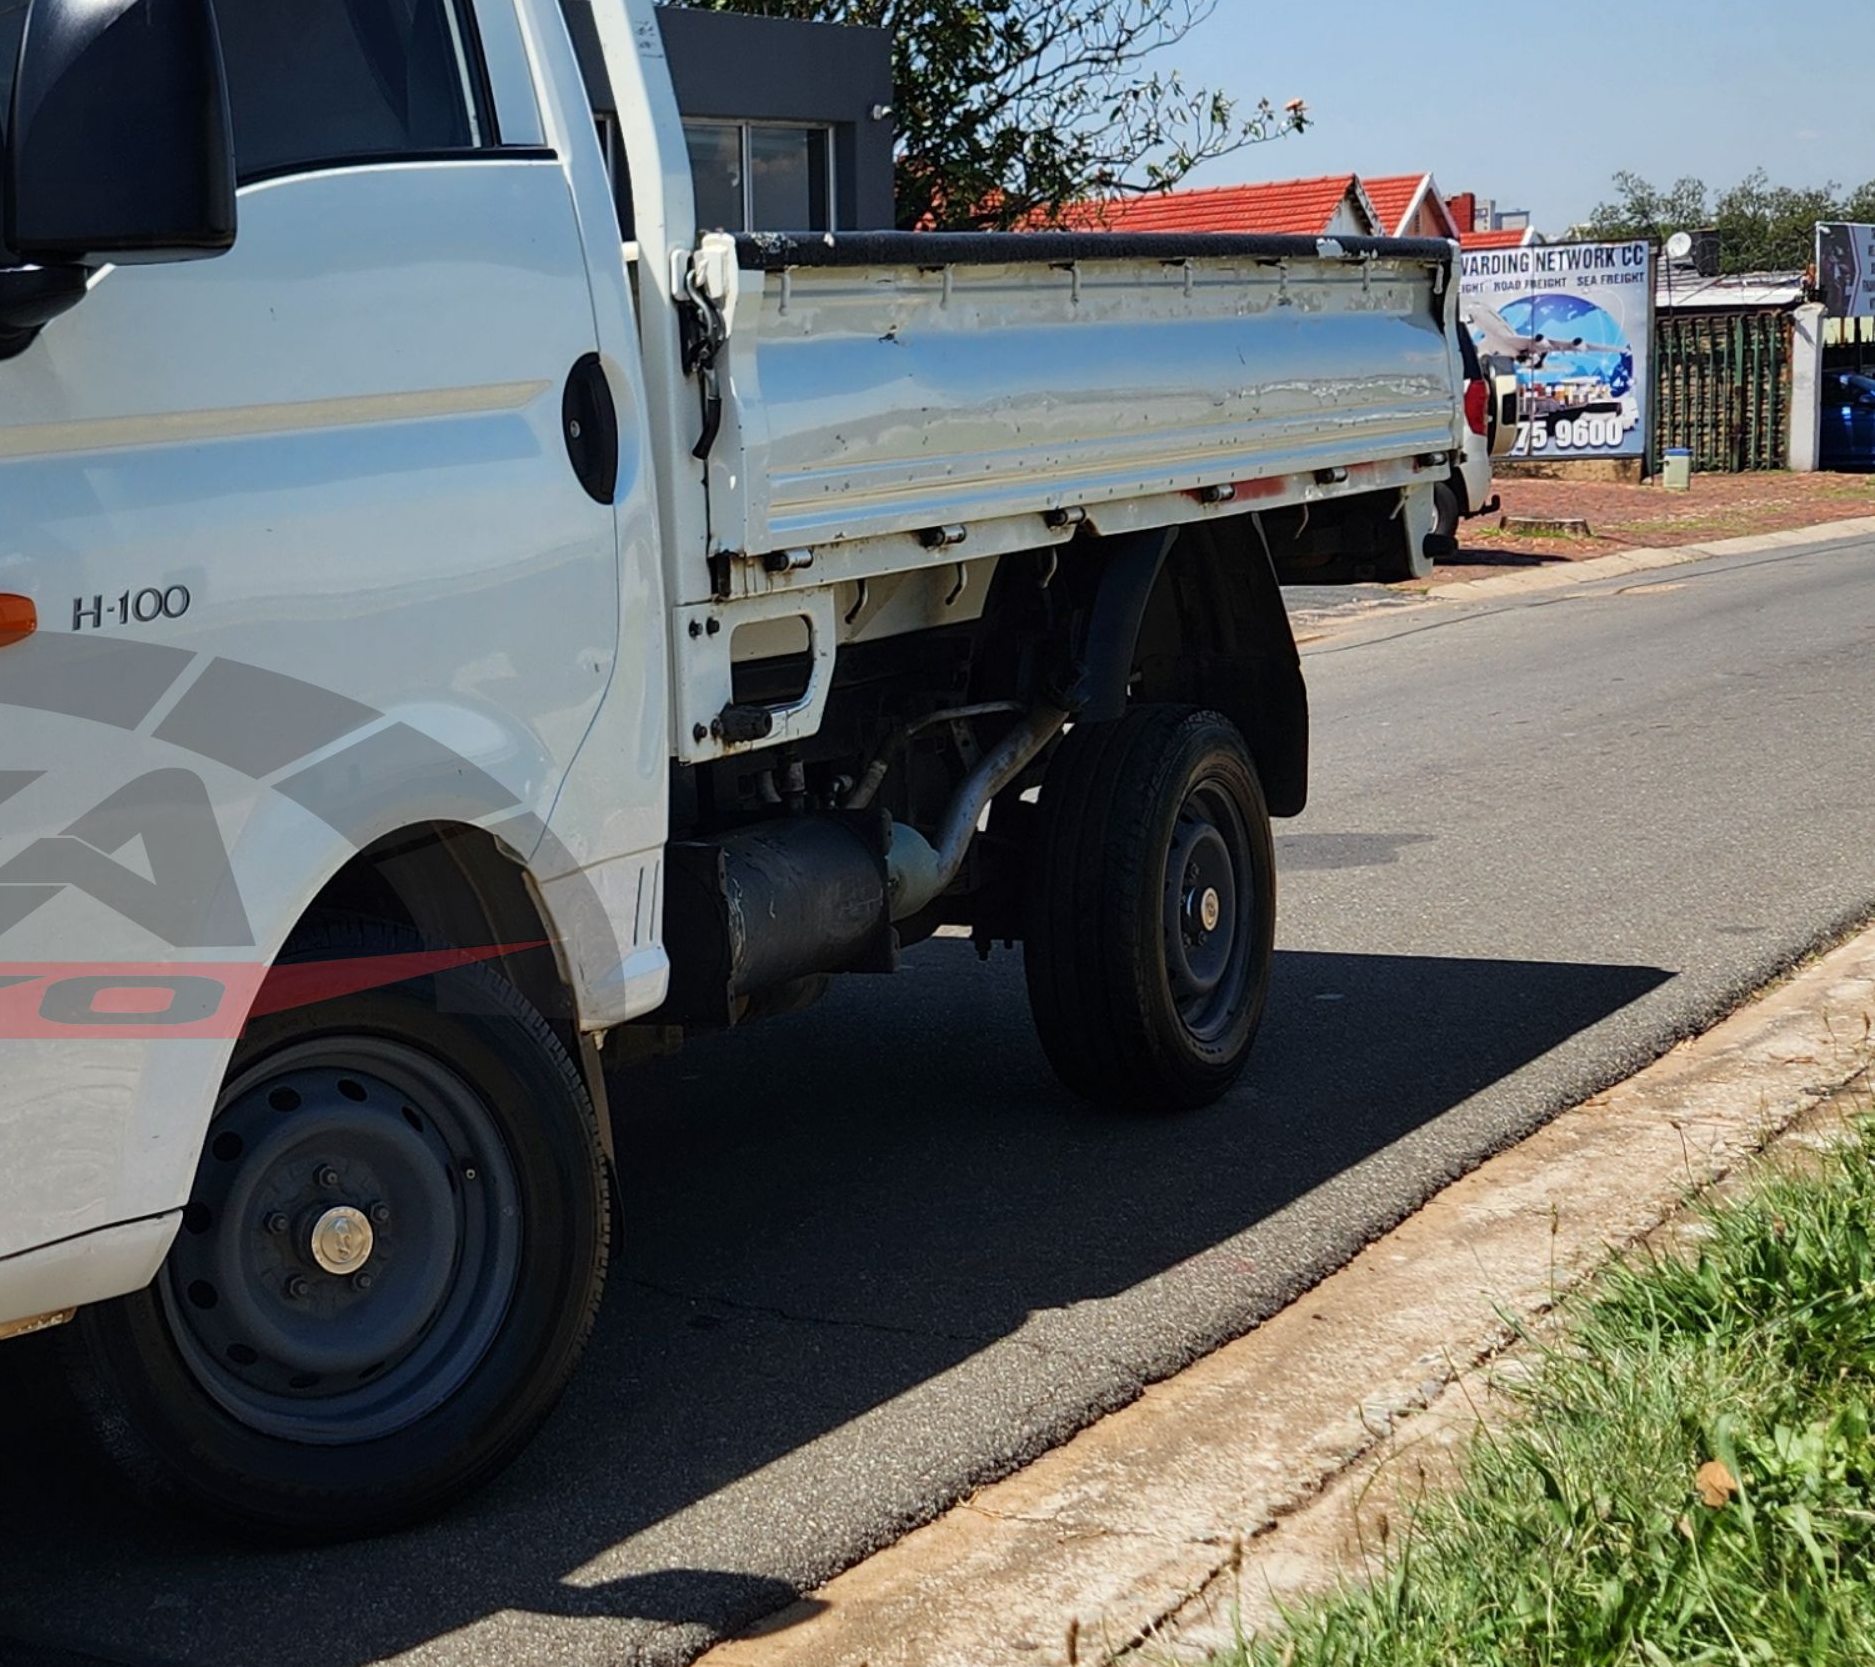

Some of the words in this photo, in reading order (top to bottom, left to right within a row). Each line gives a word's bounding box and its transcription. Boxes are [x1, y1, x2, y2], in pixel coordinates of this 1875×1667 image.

[1535, 247, 1616, 273] NETWORK
[1621, 244, 1644, 267] CC
[1462, 282, 1484, 294] IGHT
[1524, 277, 1567, 290] FREIGHT
[1577, 274, 1597, 287] SEA
[1600, 272, 1645, 285] FREIGHT
[1555, 418, 1624, 449] 9600
[71, 584, 190, 631] H-100
